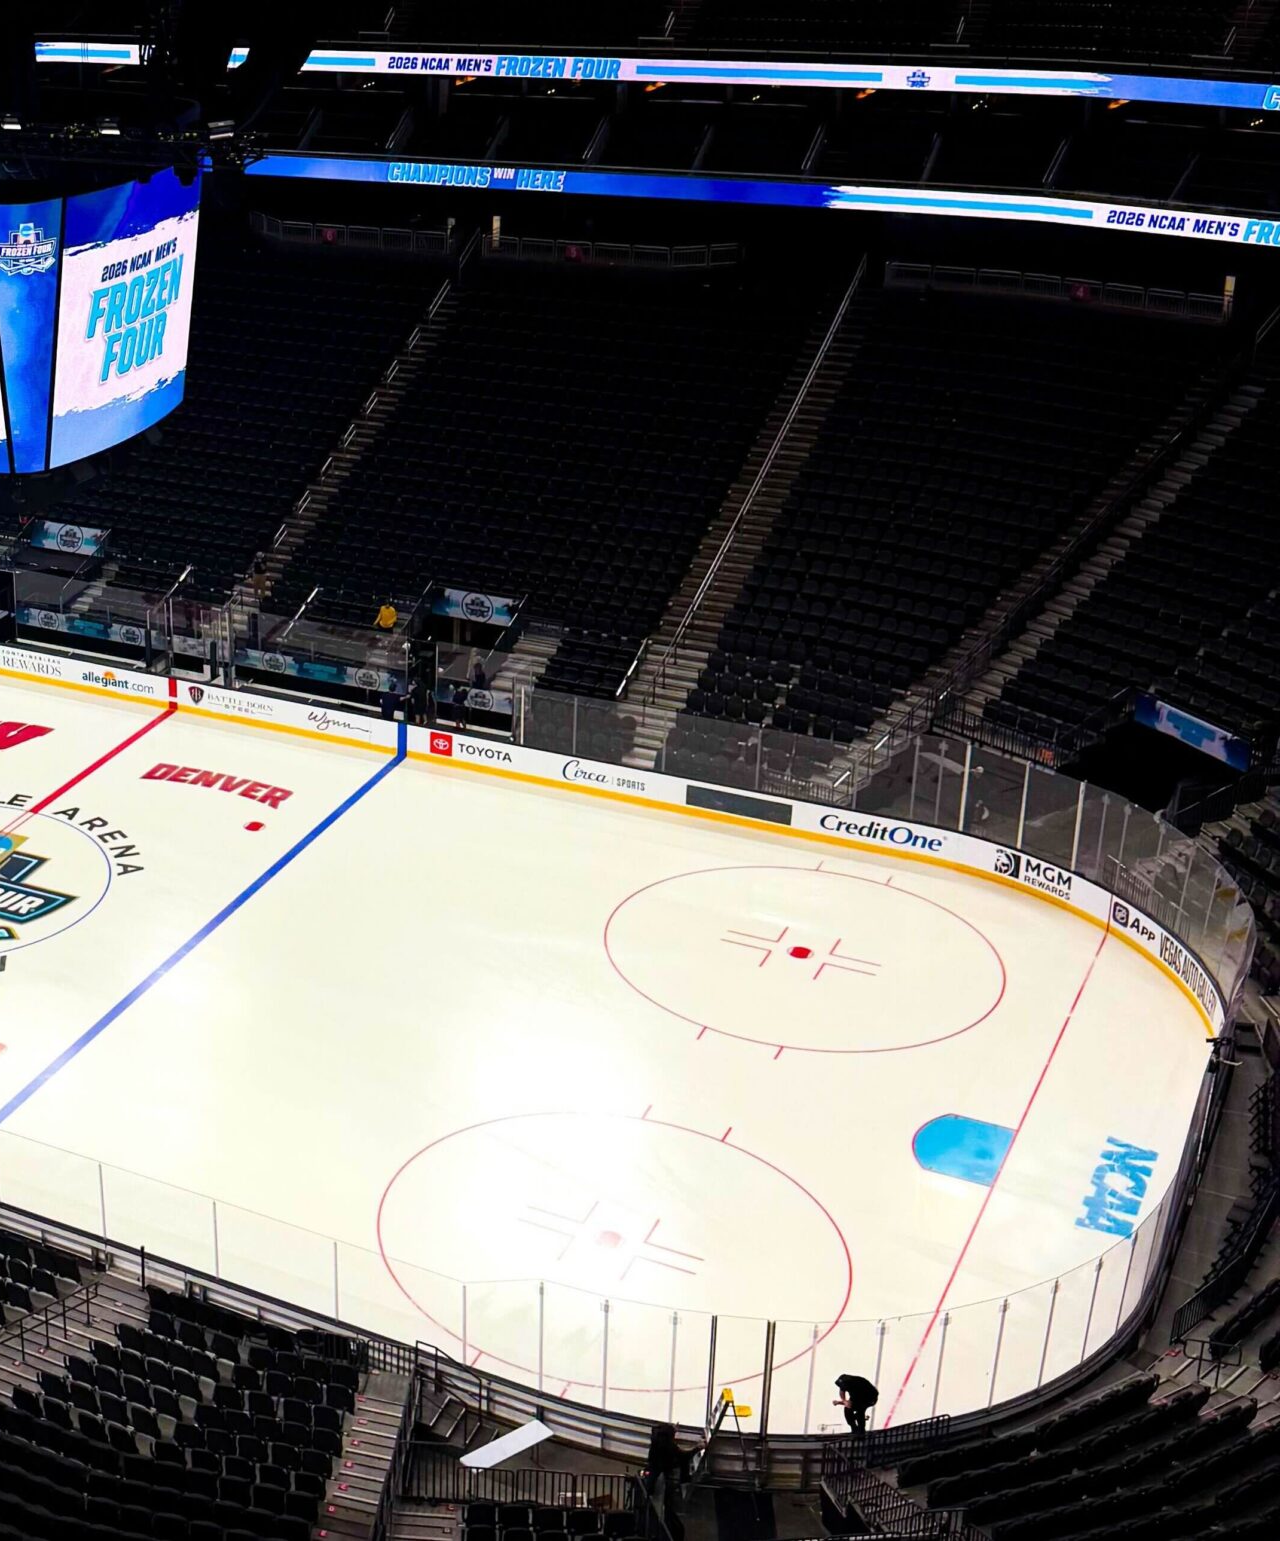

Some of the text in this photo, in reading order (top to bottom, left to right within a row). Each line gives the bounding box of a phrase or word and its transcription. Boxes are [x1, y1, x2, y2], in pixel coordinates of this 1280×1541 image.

[388, 56, 621, 80] 2026 NCAA MEN'S FROZEN FOUR
[388, 162, 566, 192] CHAMPIONS WIN HERE
[1107, 210, 1146, 227] 2026
[1148, 213, 1187, 232] NCAA
[1192, 218, 1241, 237] MEN'S
[1, 246, 32, 257] FROZEN
[33, 243, 52, 256] FOUR
[101, 237, 178, 283] 2026 NCAA MEN'S
[86, 254, 184, 339] FROZEN
[100, 312, 167, 383] FOUR
[3, 656, 61, 677] REWARDS
[82, 671, 154, 694] allegiant.com
[207, 692, 274, 714] BATTLE BORN
[224, 704, 256, 716] STEEL
[308, 711, 371, 733] Wynn
[458, 743, 513, 763] TOYOTA
[140, 762, 294, 809] DENVER
[562, 759, 646, 792] Circa SPORTS
[52, 806, 145, 877] ARENA
[820, 814, 943, 852] CreditOne
[1024, 875, 1070, 901] REWARDS
[1025, 858, 1071, 891] MGM
[1160, 931, 1183, 975] VEGAS
[1182, 954, 1199, 994] AUTO
[1074, 1136, 1159, 1240] NCAA
